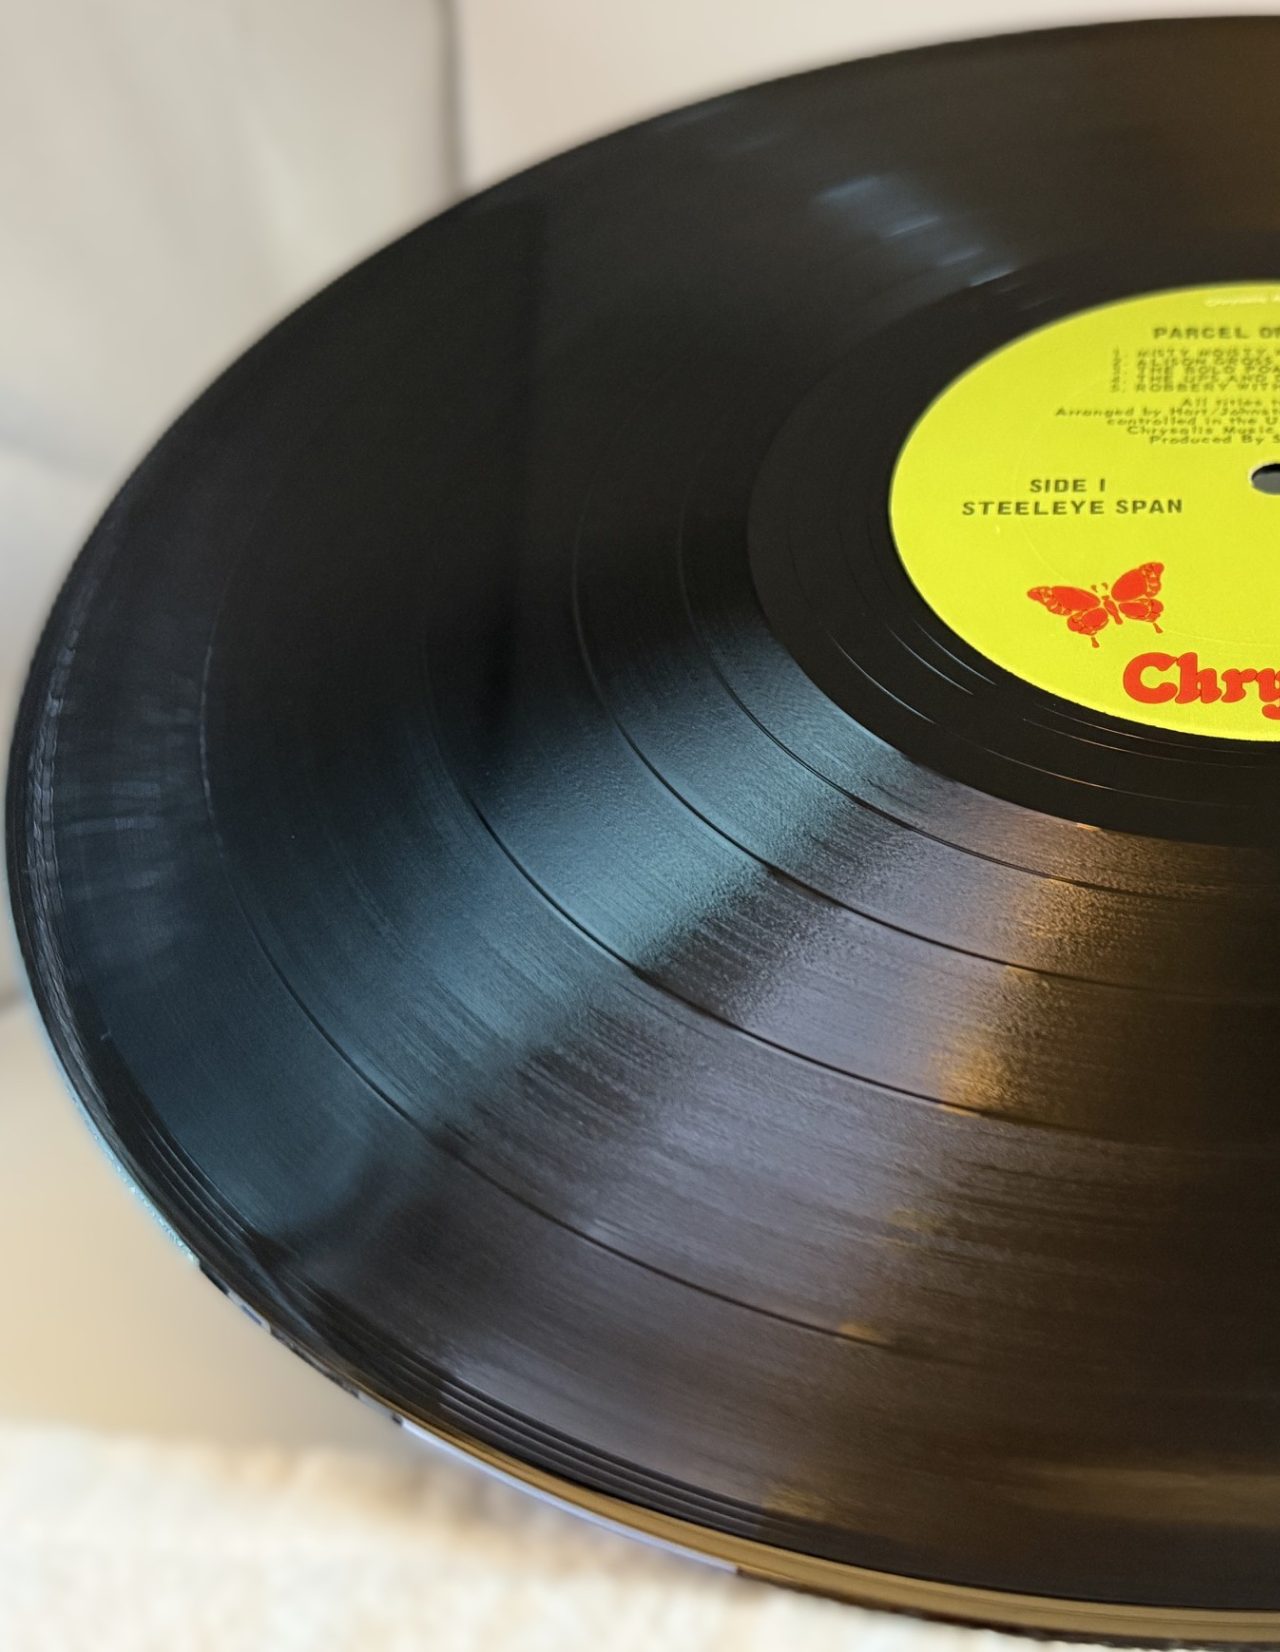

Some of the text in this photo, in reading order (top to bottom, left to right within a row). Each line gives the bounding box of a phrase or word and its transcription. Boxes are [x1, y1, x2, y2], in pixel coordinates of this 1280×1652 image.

[1153, 326, 1249, 339] PARCEL
[1136, 383, 1228, 392] ROBBERY
[1181, 398, 1207, 407] All
[1215, 398, 1263, 406] titles
[1056, 407, 1135, 417] Arranged
[1143, 407, 1161, 417] by
[1106, 417, 1197, 426] controlled
[1205, 416, 1222, 425] in
[1229, 416, 1258, 425] the
[1127, 425, 1213, 436] Chrysalis
[1223, 426, 1274, 435] Music
[1149, 435, 1232, 445] Produced
[1241, 435, 1265, 445] By
[1030, 479, 1087, 493] SIDE
[962, 499, 1183, 515] STEELEYE SPAN
